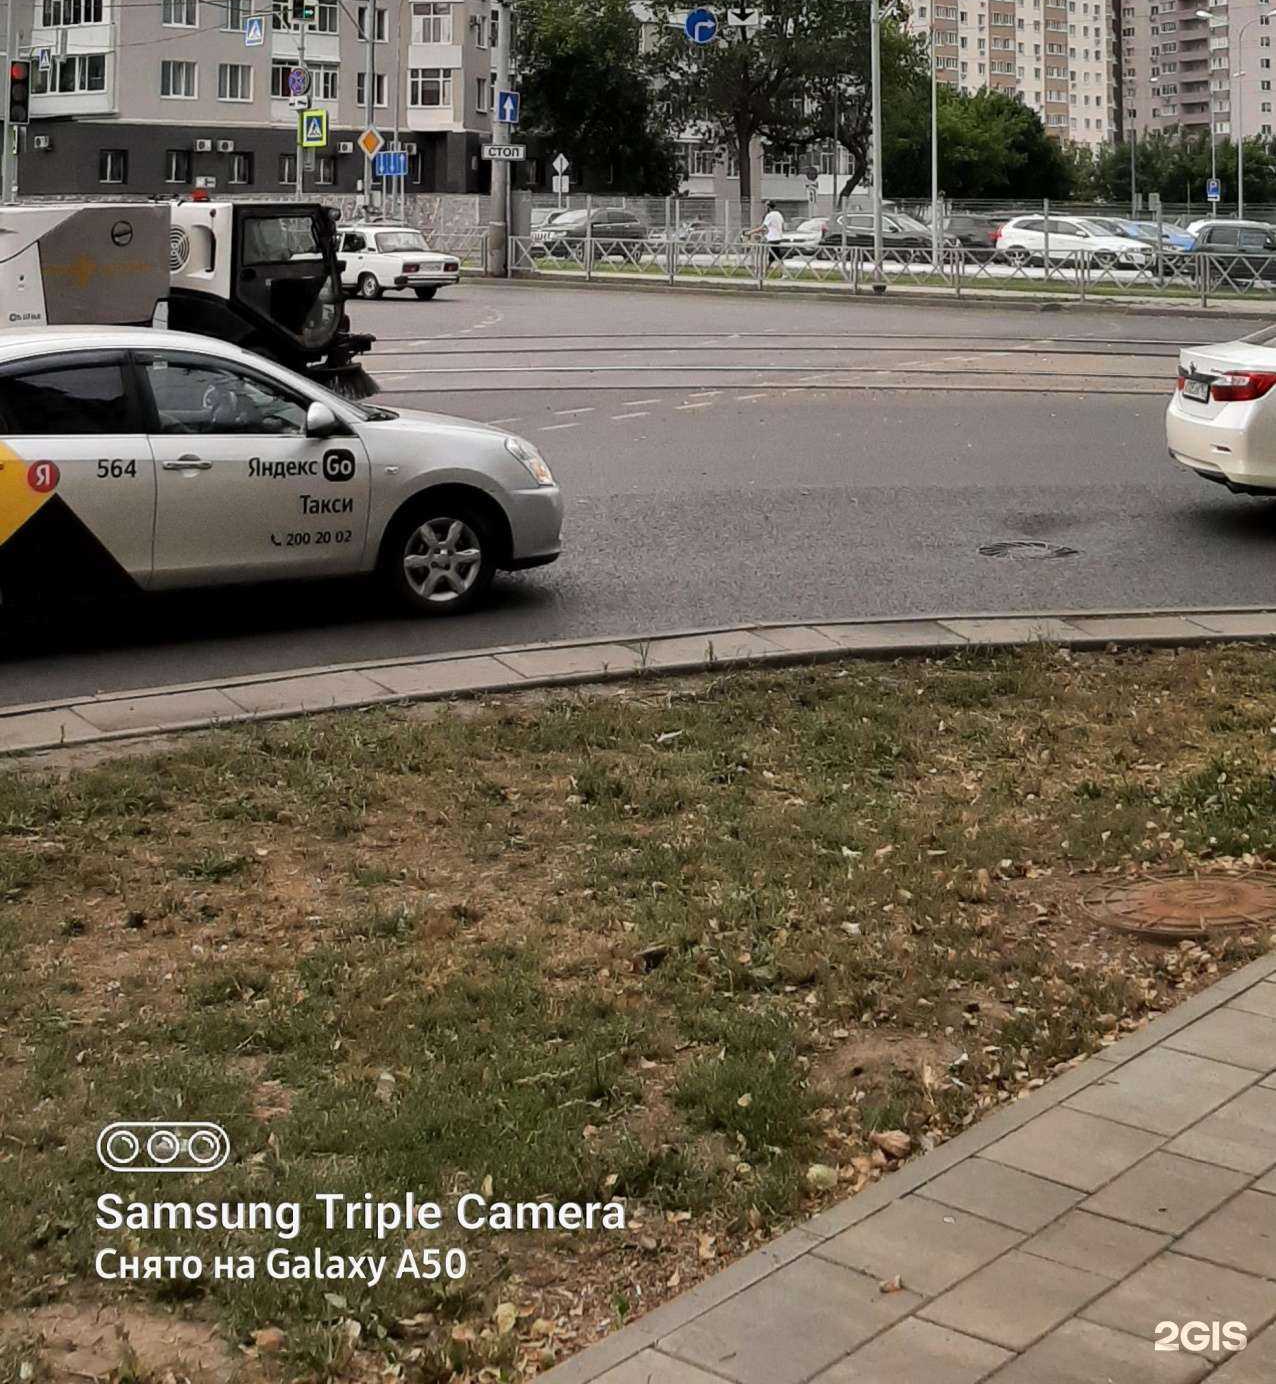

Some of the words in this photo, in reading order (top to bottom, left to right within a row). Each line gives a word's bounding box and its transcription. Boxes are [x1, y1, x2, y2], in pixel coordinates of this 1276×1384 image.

[488, 147, 520, 157] СТОП
[35, 464, 51, 487] Я
[97, 459, 137, 478] 564
[248, 457, 319, 479] Яндекс
[325, 454, 353, 476] Go
[300, 495, 353, 514] Такси
[286, 532, 311, 546] 200
[315, 531, 331, 544] 20
[335, 530, 352, 543] 02
